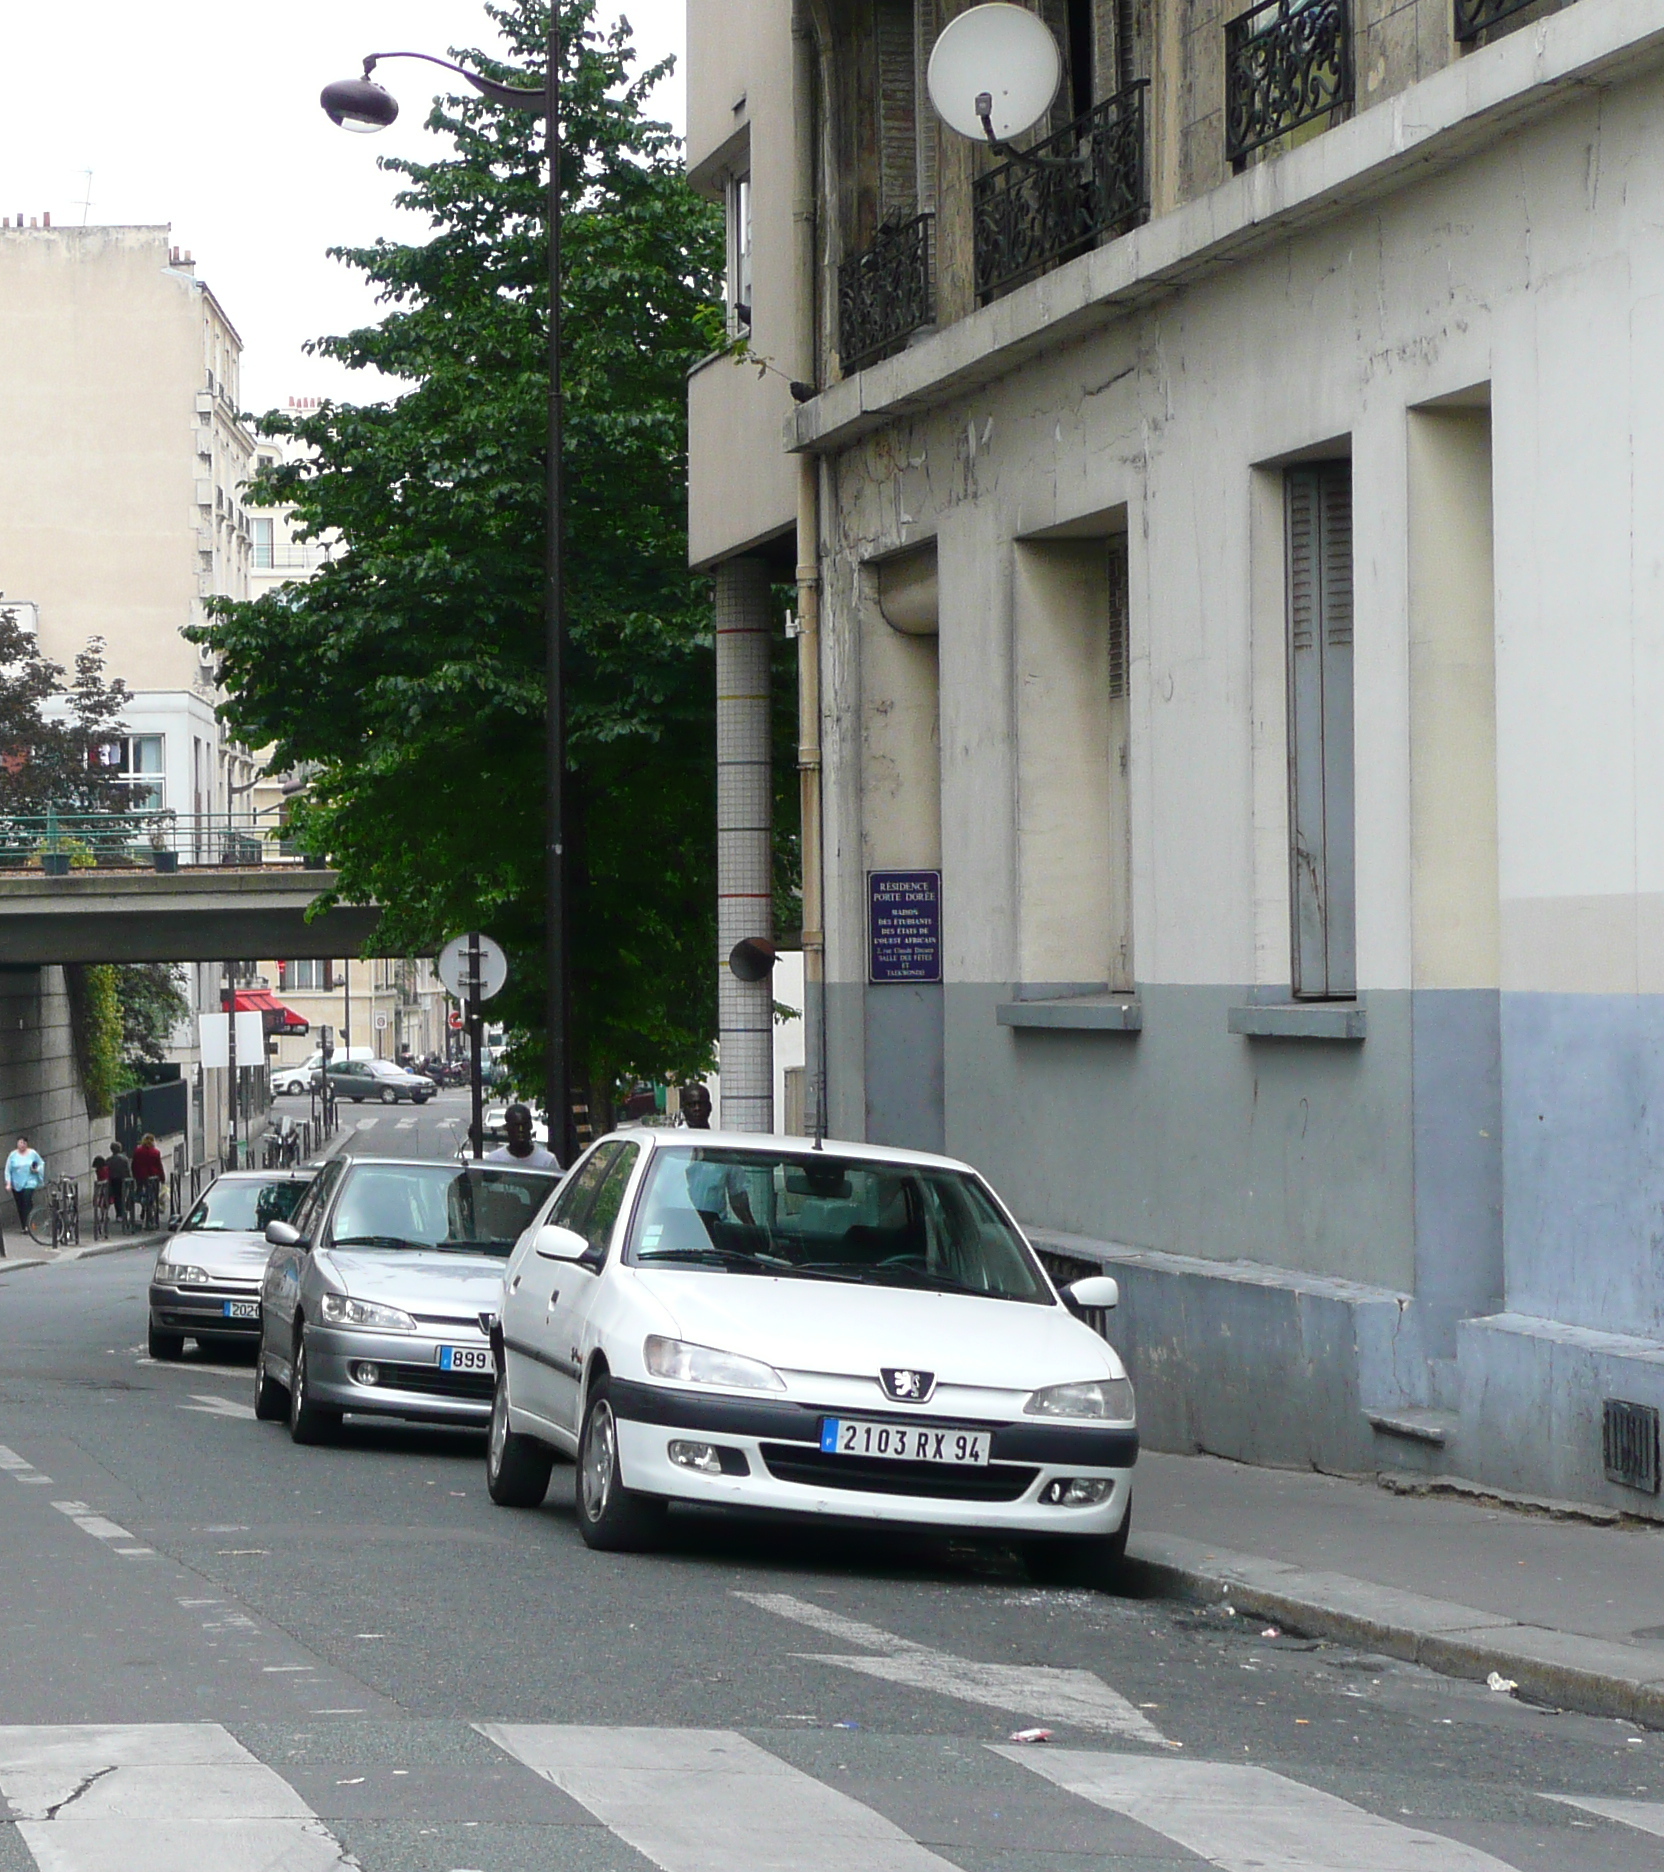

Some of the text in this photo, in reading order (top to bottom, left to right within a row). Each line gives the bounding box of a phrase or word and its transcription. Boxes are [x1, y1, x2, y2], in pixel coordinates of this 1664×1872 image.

[880, 881, 929, 891] RÉSIDENCE
[874, 892, 935, 901] PORTE DORÉE
[452, 1351, 486, 1369] 899
[844, 1425, 907, 1456] 2103
[916, 1432, 946, 1460] RX
[954, 1436, 980, 1462] 94
